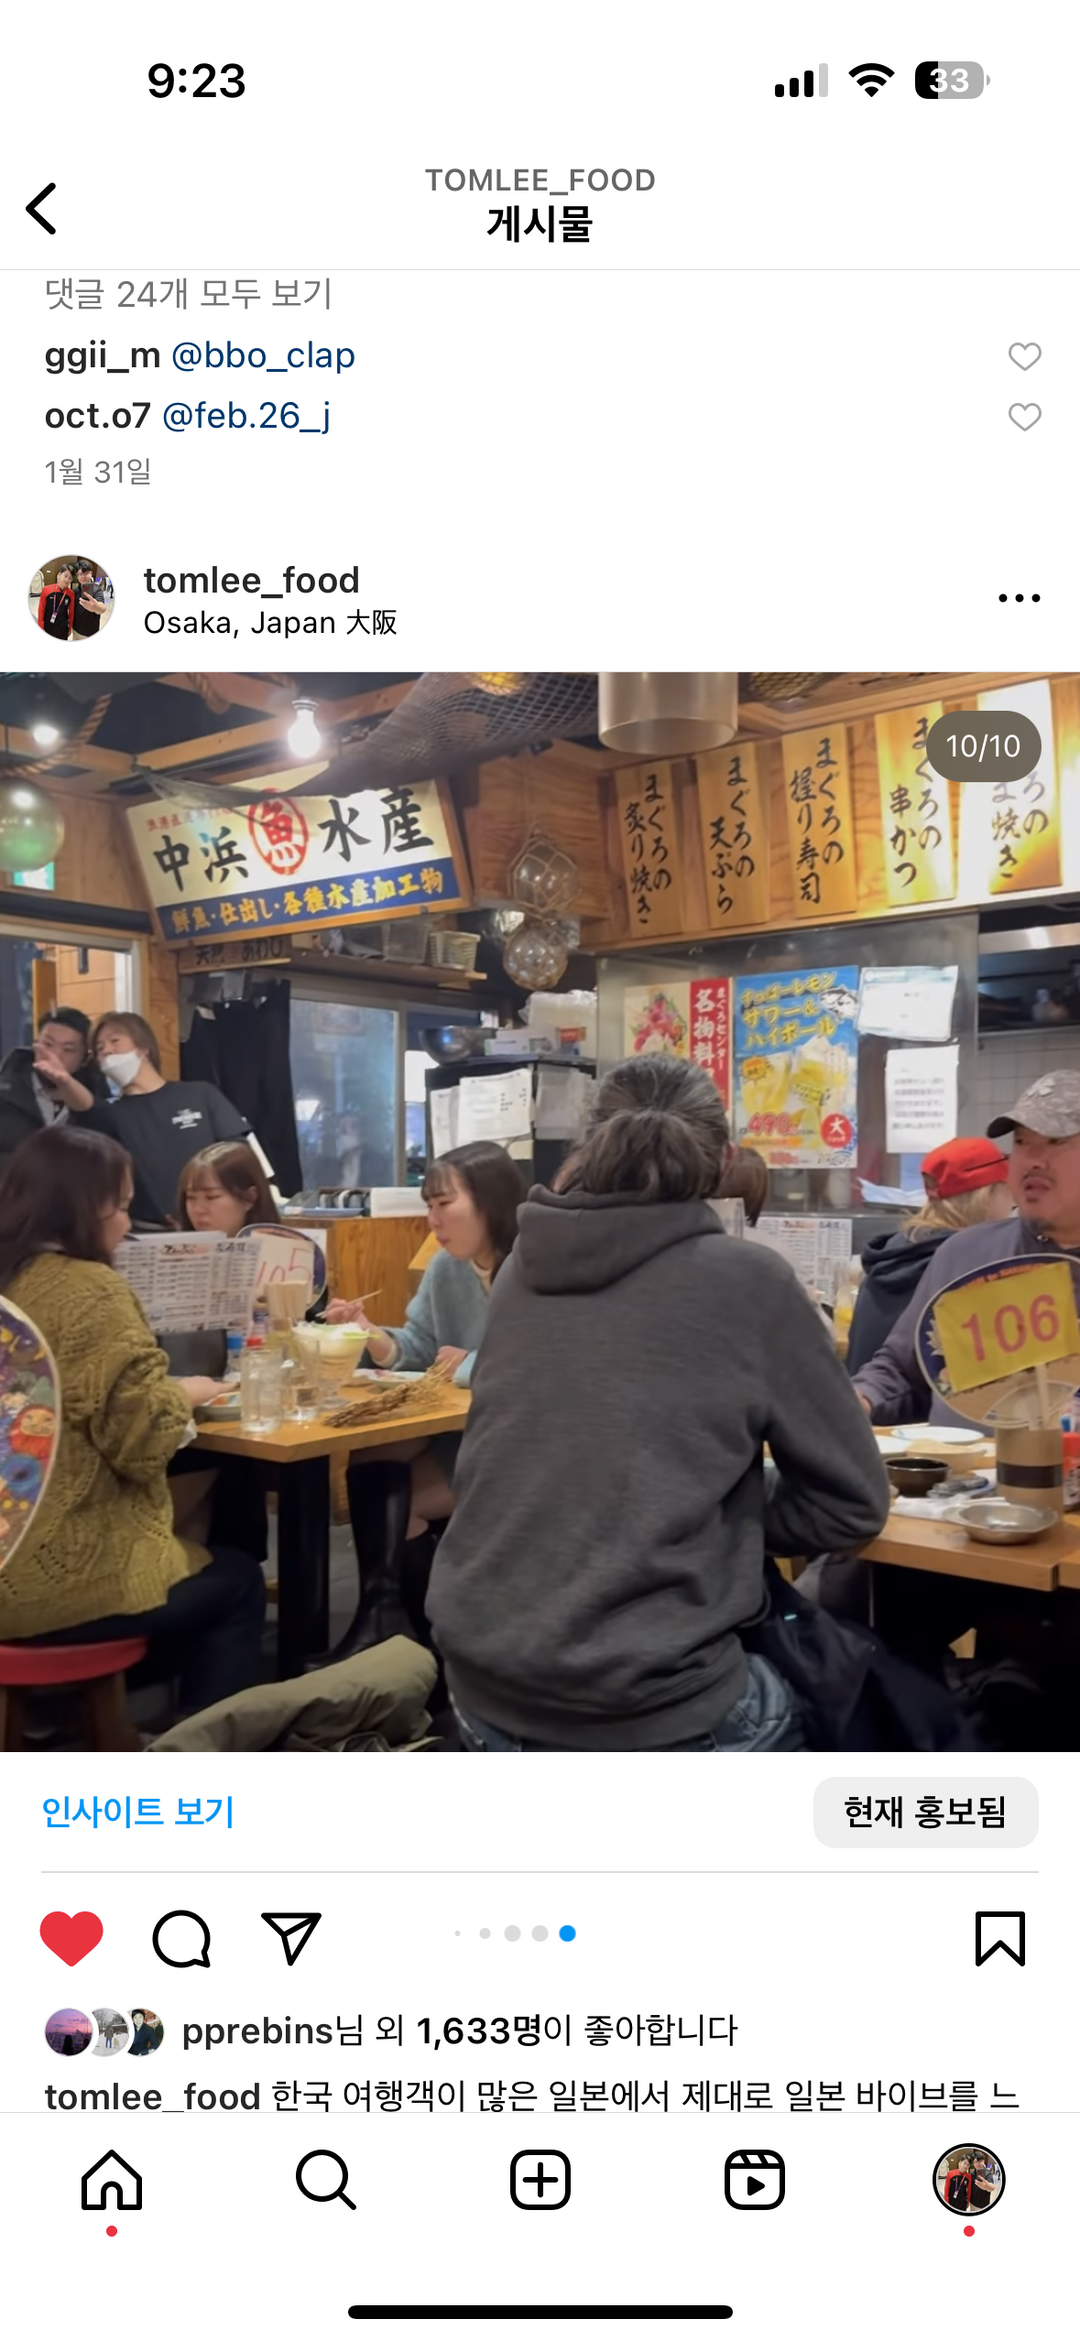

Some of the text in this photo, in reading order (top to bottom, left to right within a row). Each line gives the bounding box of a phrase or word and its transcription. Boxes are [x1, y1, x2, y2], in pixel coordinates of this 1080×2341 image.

[148, 63, 245, 98] 9:23
[929, 68, 969, 92] 33
[425, 168, 656, 196] TOMLEE_FOOD
[487, 205, 593, 243] 게시물
[46, 278, 330, 311] 댓글 24개 모두 보기
[45, 340, 356, 374] ggii_m @bbo_clap
[45, 400, 330, 434] oct.o7 @feb.26_j
[45, 457, 151, 486] 1월 31일
[144, 566, 359, 599] tomlee_food
[144, 608, 398, 640] Osaka, Japan 大阪
[727, 756, 755, 877] まぐろの
[816, 737, 844, 865] まぐろの
[1023, 771, 1049, 835] ろの
[153, 788, 434, 892] 中浜 魚 水産
[644, 774, 672, 890] まぐろの
[789, 766, 821, 904] 握り寿司
[889, 783, 917, 888] 串かつ
[991, 782, 1021, 878] ま焼き
[624, 802, 653, 923] 炙り焼き
[709, 815, 734, 915] 天ぷら
[693, 988, 715, 1077] 名物料
[745, 1016, 836, 1050] ハイボール
[961, 1294, 1060, 1363] 106
[42, 1795, 233, 1830] 인사이트 보기
[843, 1795, 1005, 1830] 현재 홍보됨
[183, 2013, 739, 2050] pprebins님 외 1,633명이 좋아합니다
[45, 2080, 1020, 2112] tomlee_food 한국 여행객이 많은 일본에서 제대로 일본 바이브를 느
